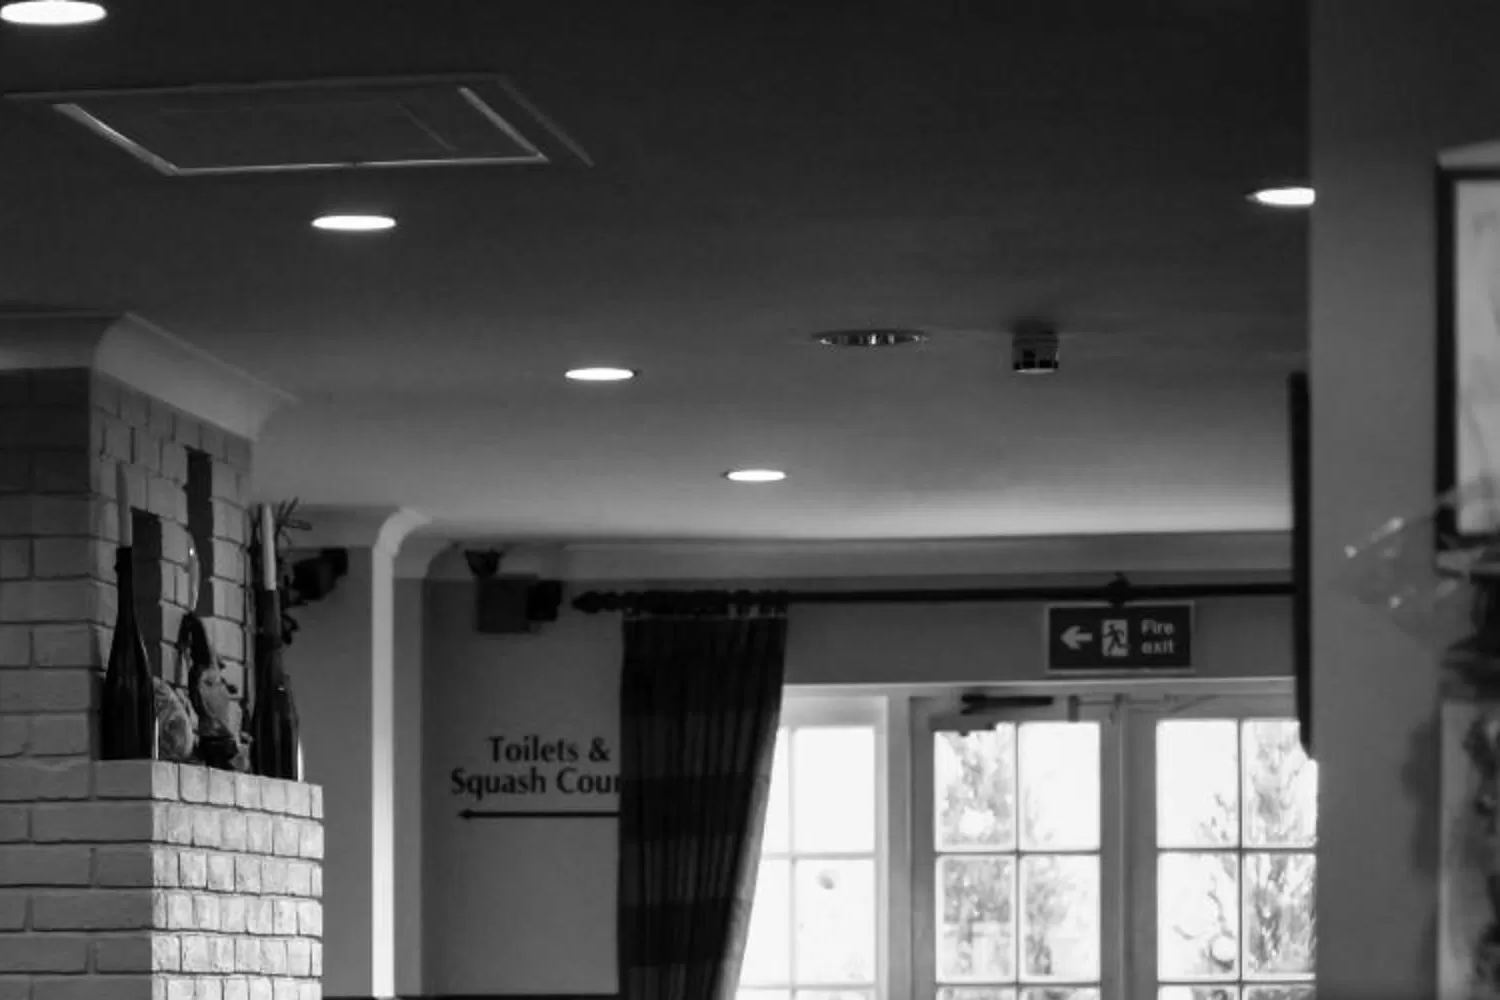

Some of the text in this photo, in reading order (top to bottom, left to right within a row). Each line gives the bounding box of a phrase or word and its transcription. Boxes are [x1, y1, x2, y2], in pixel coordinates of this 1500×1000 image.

[1141, 618, 1175, 635] Fire
[1141, 638, 1174, 654] exit
[487, 735, 611, 762] Toilets &
[451, 766, 547, 800] Squash
